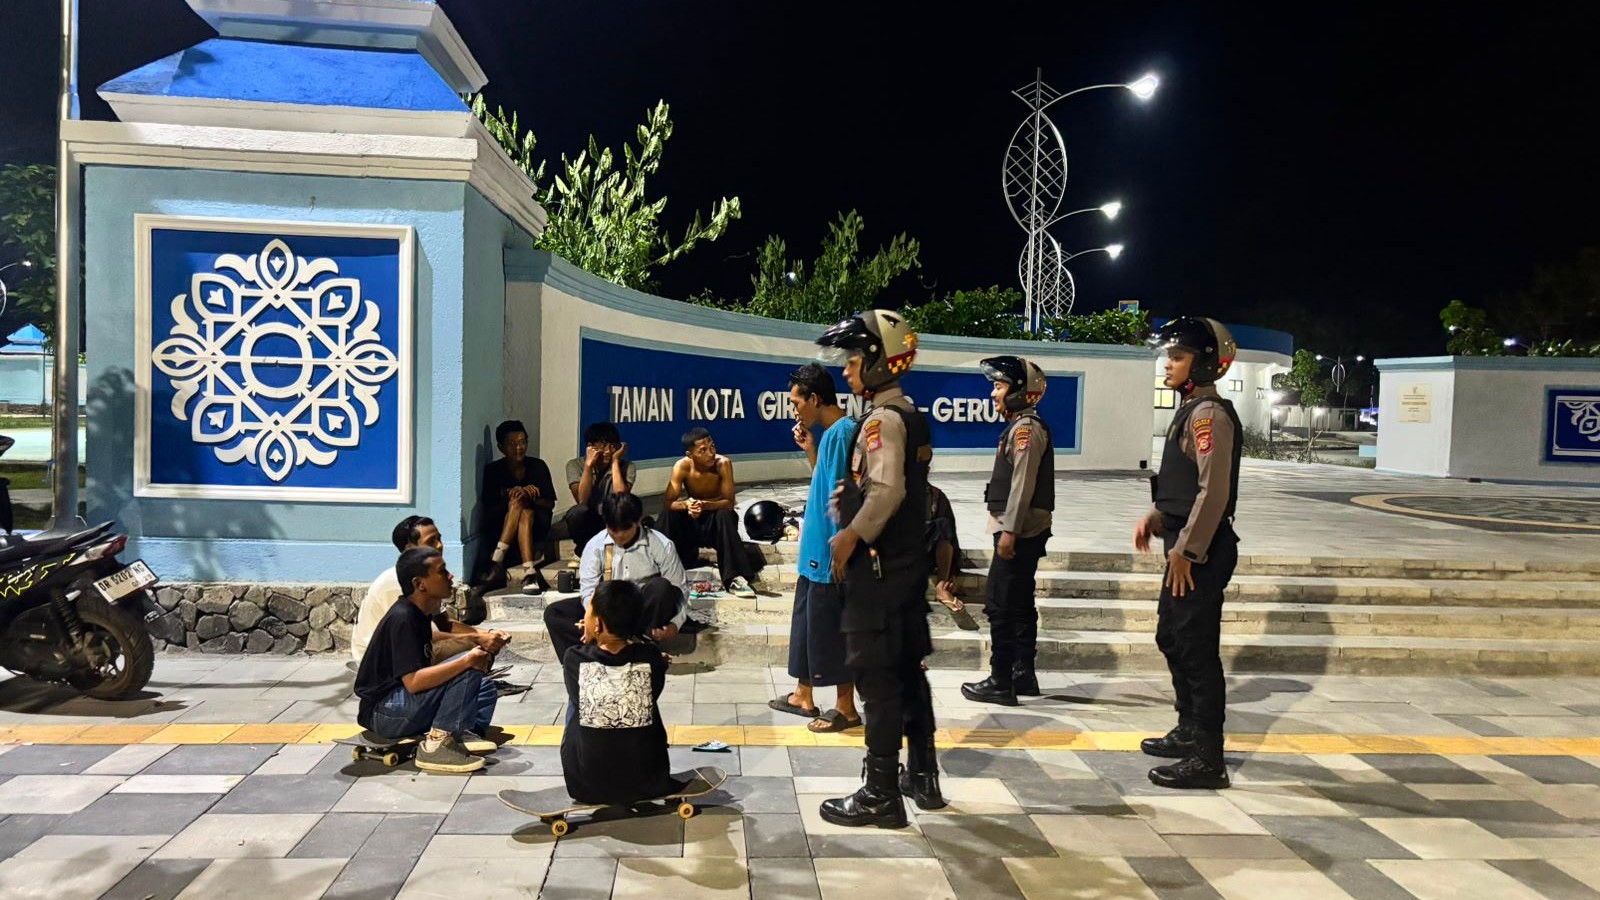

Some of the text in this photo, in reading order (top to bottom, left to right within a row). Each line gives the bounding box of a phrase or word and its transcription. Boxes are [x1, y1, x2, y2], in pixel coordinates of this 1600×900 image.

[609, 386, 674, 423] TAMAN
[689, 388, 745, 421] KOTA
[758, 390, 796, 421] GIR
[932, 396, 1006, 423] GERU
